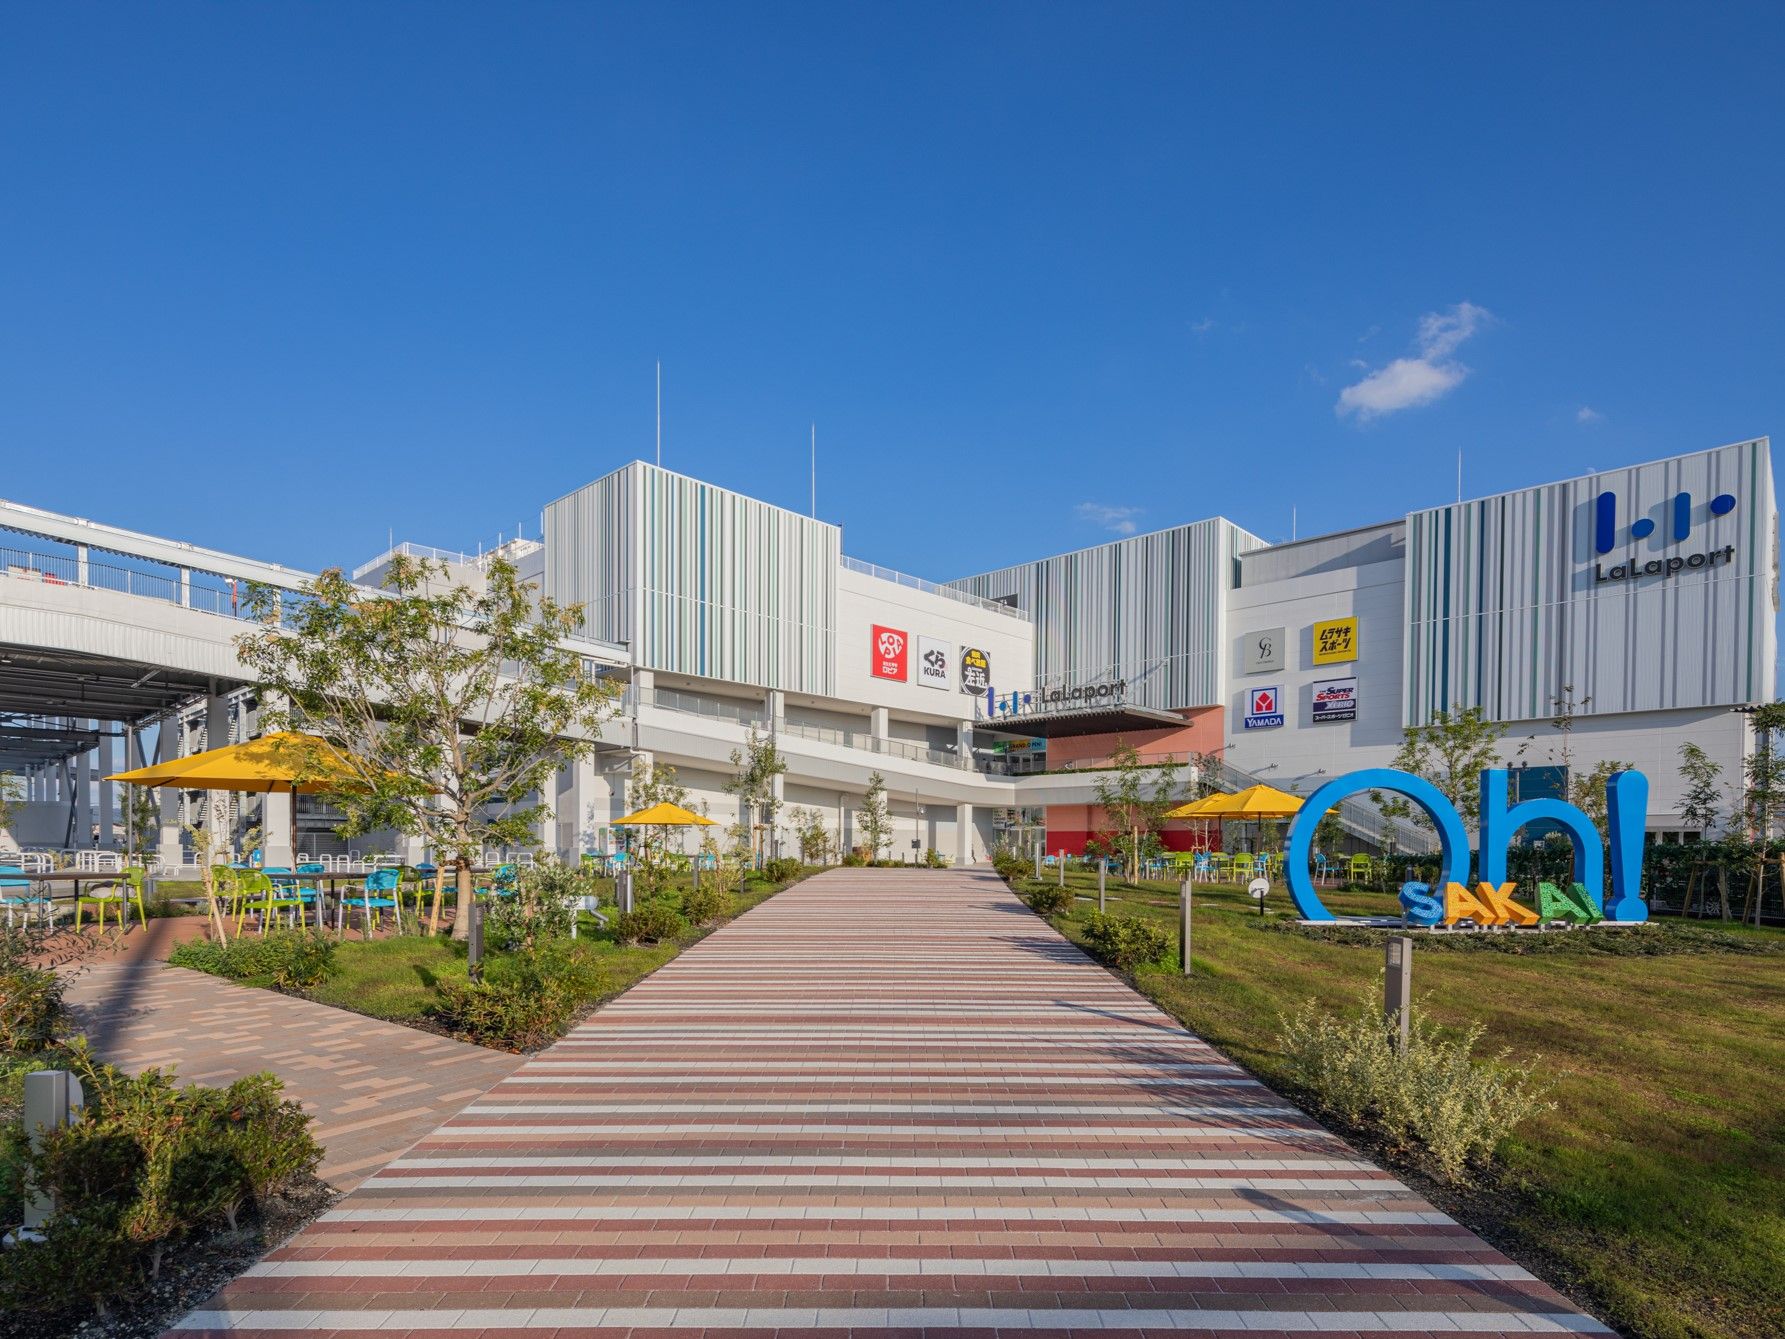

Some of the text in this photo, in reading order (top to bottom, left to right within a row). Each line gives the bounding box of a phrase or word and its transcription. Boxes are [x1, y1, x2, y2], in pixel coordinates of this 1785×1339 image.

[1595, 544, 1735, 582] LaLaport
[1319, 626, 1352, 640] ムラサキ
[1319, 637, 1352, 653] スポーツ
[924, 649, 946, 669] くら
[924, 666, 946, 679] KURA
[1041, 678, 1127, 704] LaLaport
[1246, 717, 1282, 728] YAMADA
[1283, 768, 1649, 922] Oh!
[1398, 881, 1605, 926] SAKAI
